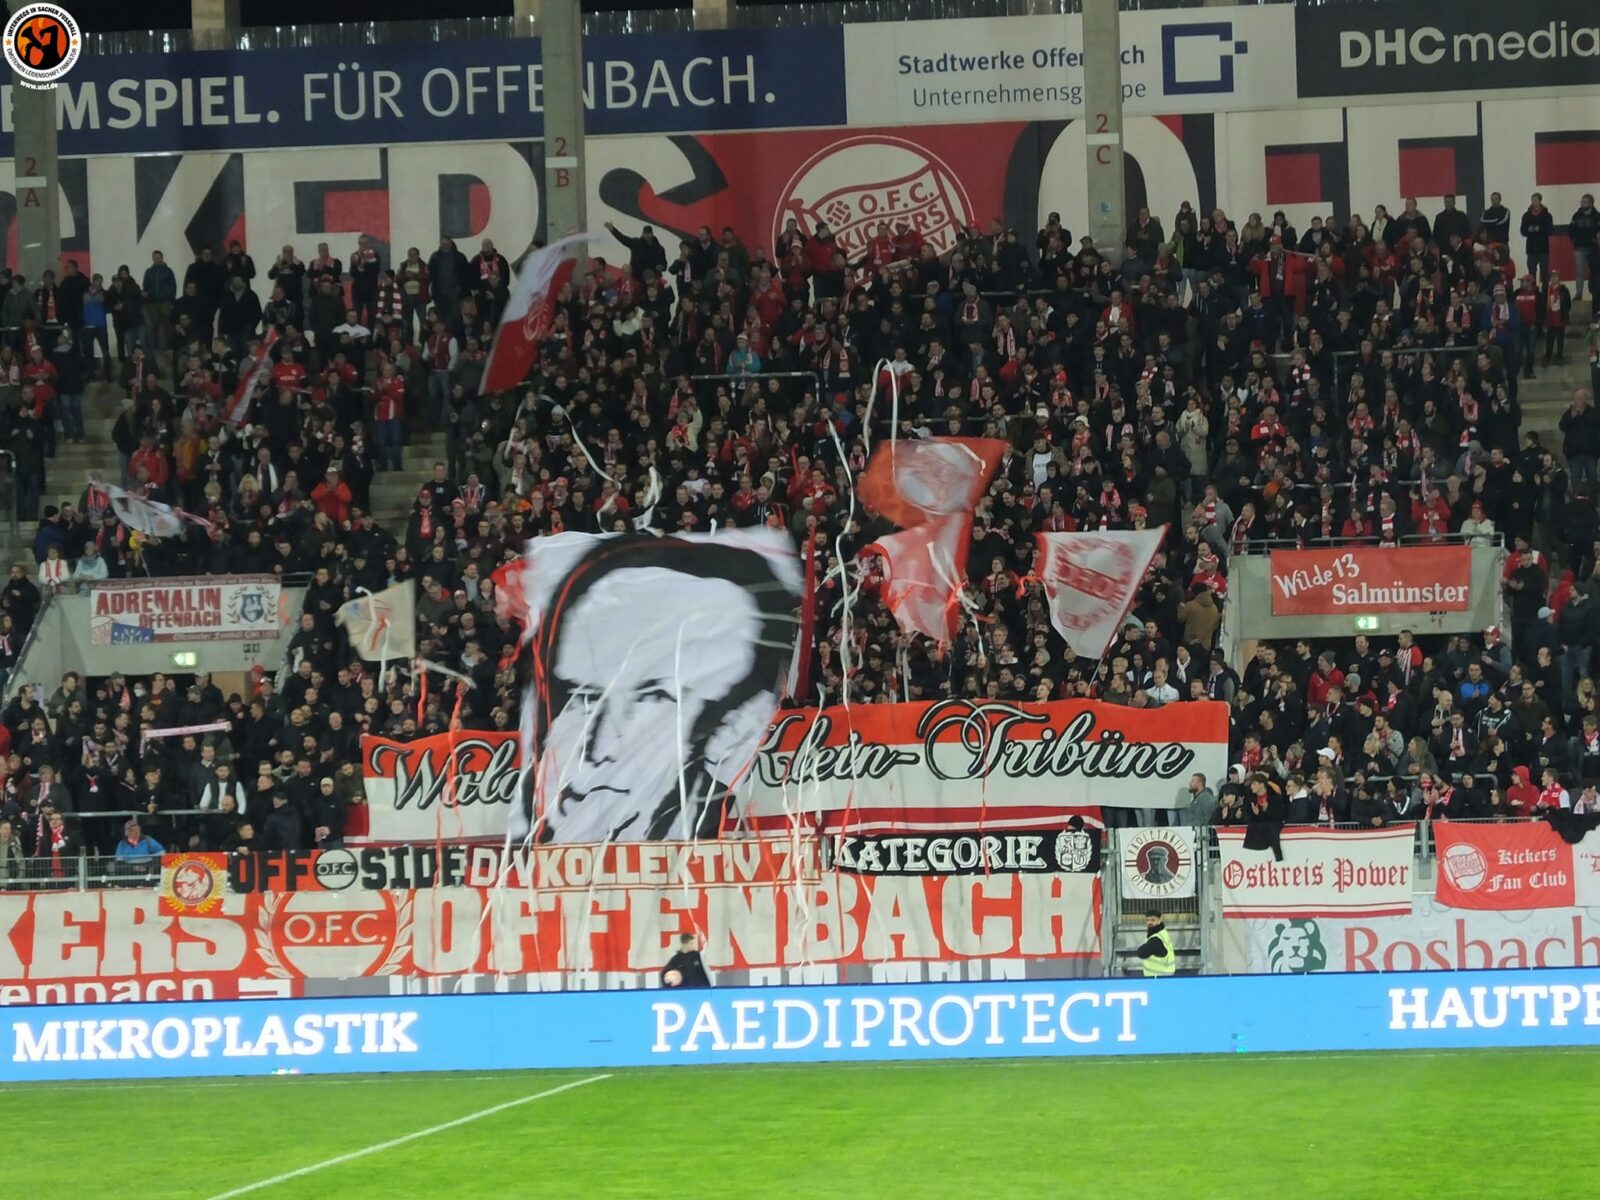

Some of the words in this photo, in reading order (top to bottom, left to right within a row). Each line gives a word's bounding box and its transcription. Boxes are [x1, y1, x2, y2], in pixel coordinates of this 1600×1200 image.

[898, 49, 1025, 75] Stadtwerke
[1032, 44, 1145, 69] Offech
[304, 62, 404, 121] FÜR
[912, 82, 1146, 107] Unternehmensgpe
[1095, 113, 1109, 134] 2
[554, 137, 567, 157] 2
[1095, 145, 1111, 165] C
[25, 157, 37, 176] 2
[554, 168, 570, 188] B
[23, 188, 41, 207] A
[858, 182, 935, 214] O.F.C.
[1273, 564, 1333, 600] Wilde
[1332, 553, 1360, 579] 13
[96, 587, 222, 616] ADRENALIN
[1332, 581, 1468, 606] Salmünster
[138, 610, 222, 629] OFFENBACH
[538, 840, 761, 889] KOLLEKTIV
[833, 834, 1048, 872] KATEGORIE
[1497, 847, 1557, 866] Kickers
[230, 849, 315, 894] OFF
[316, 862, 357, 876] O.F.C.
[360, 846, 467, 891] SIDE
[1222, 858, 1324, 890] Ostkreis
[1331, 857, 1409, 894] Power
[1486, 873, 1522, 893] Fan
[1528, 869, 1568, 889] Club
[283, 912, 388, 944] O.F.C.
[412, 871, 1101, 975] OFFENBACH
[12, 1011, 419, 1062] MIKROPLASTIK
[650, 991, 1149, 1053] PAEDIPROTECT
